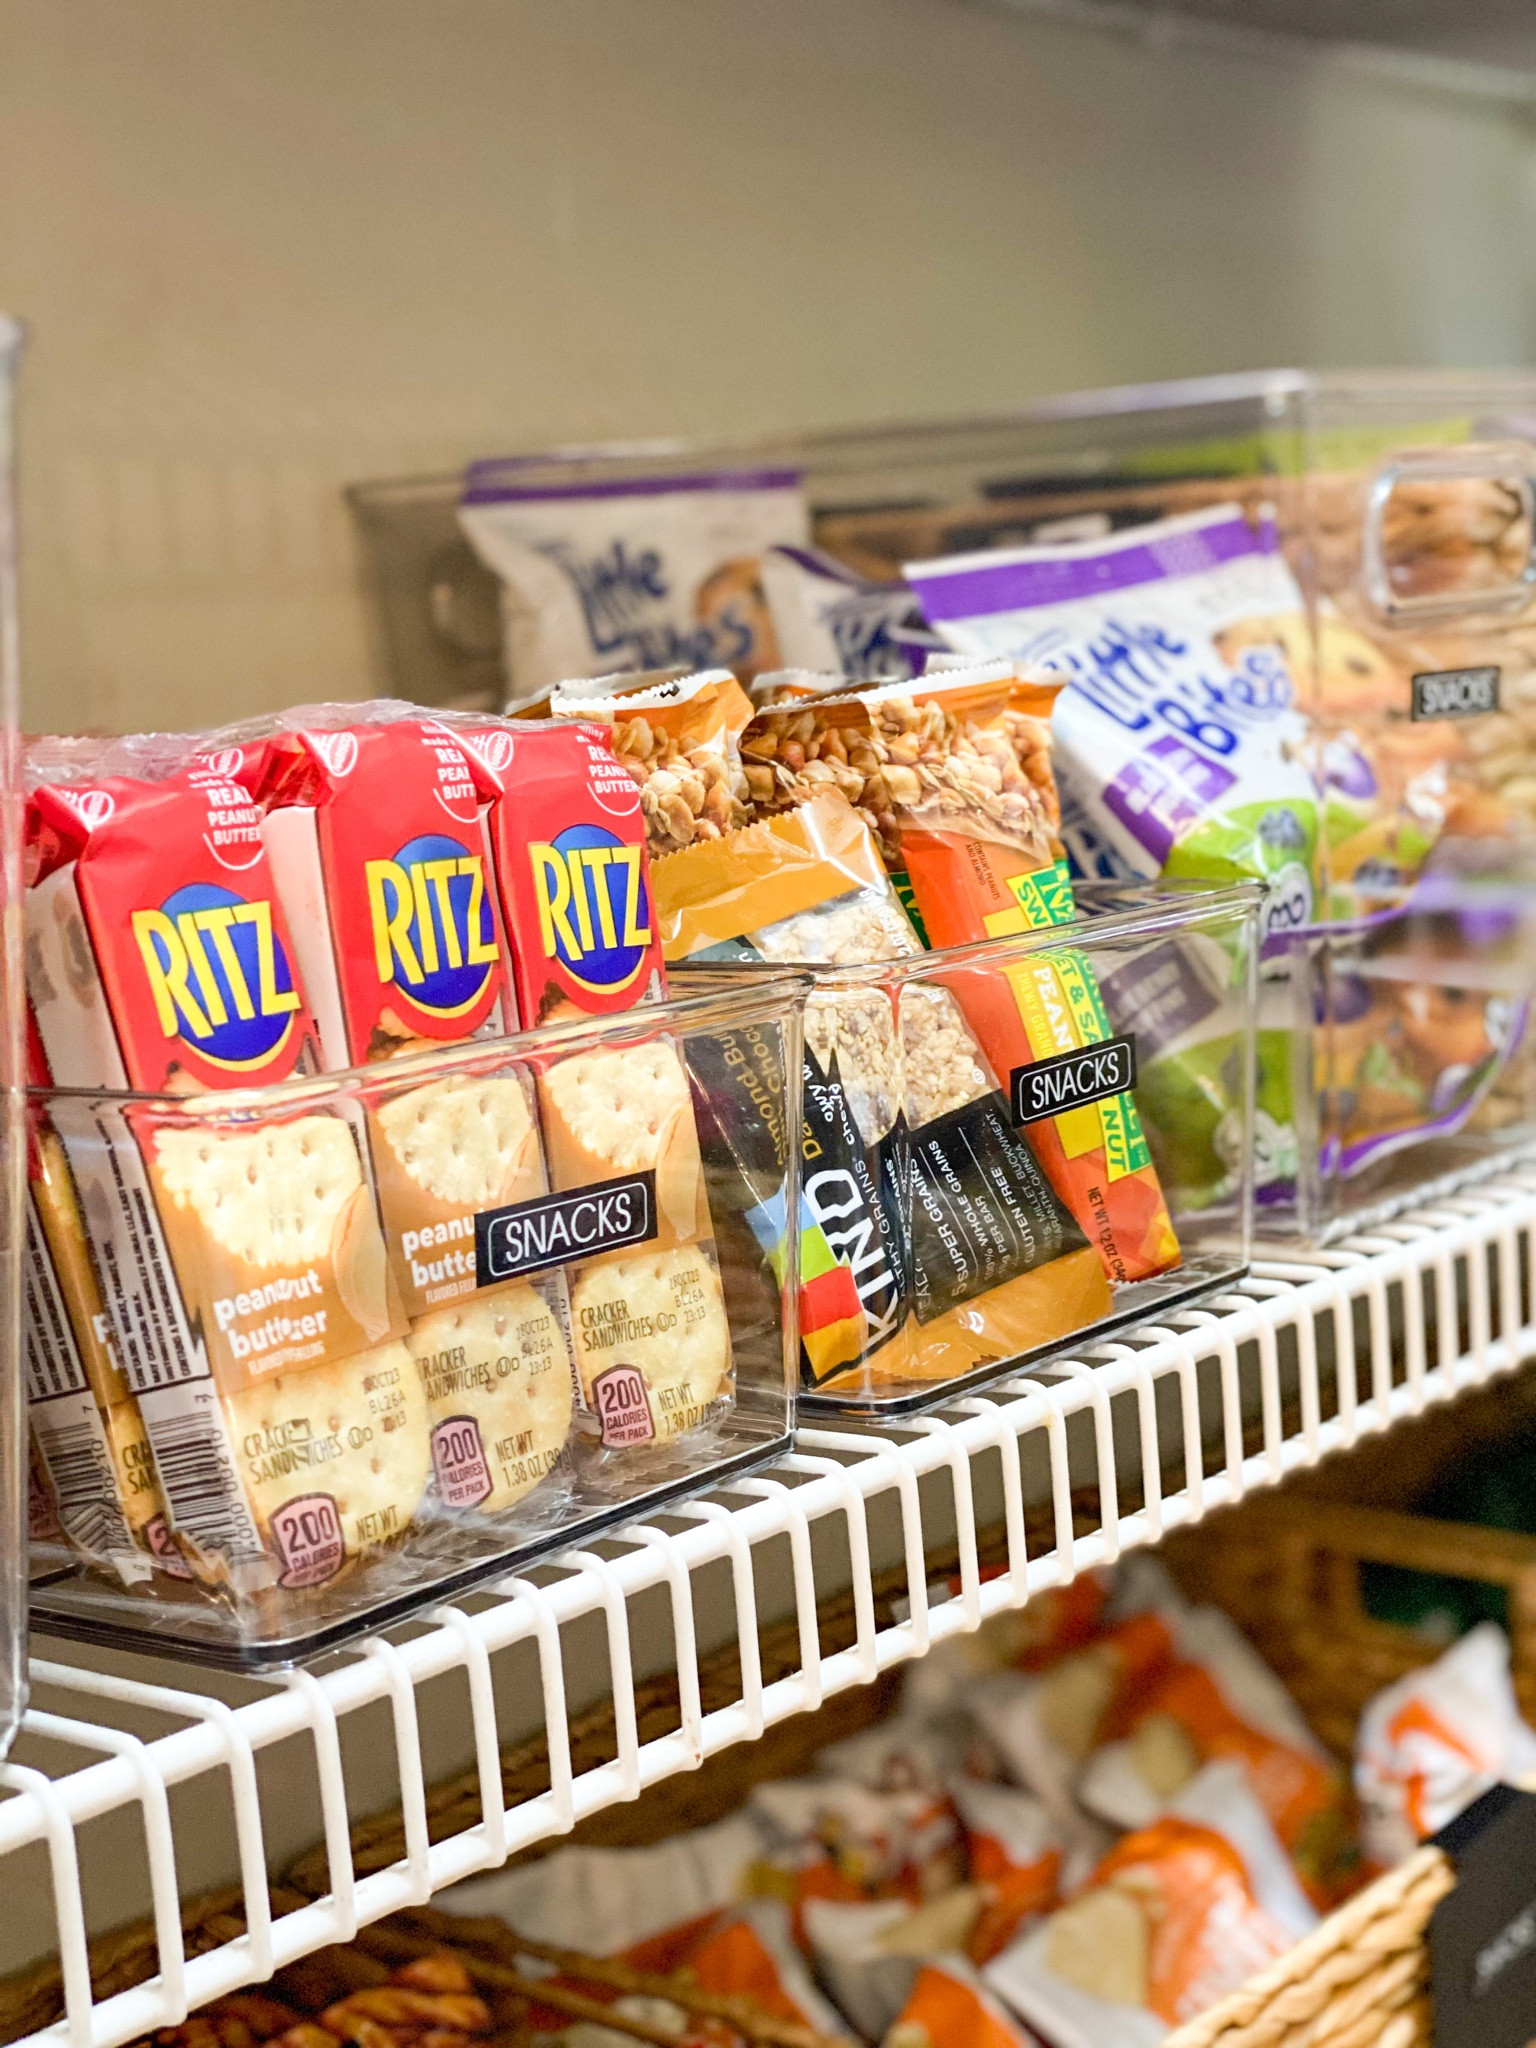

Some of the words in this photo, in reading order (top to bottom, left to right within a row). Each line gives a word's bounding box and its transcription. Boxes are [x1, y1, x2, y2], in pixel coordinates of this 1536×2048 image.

[435, 748, 467, 764] REA
[589, 764, 630, 778] PEANU
[443, 784, 477, 800] BUTT
[208, 808, 258, 827] PEANU
[966, 843, 977, 858] AND
[970, 856, 987, 887] ALMOND
[973, 841, 991, 874] CONTAINS
[984, 872, 1001, 901] PEANUTS
[365, 856, 499, 986] RITZ
[528, 842, 652, 961] RITZ
[131, 900, 301, 1039] RITZ
[1032, 966, 1074, 1049] PEAN
[1069, 985, 1084, 1005] &
[1031, 1013, 1056, 1058] GRANO
[1031, 1051, 1120, 1110] SNACKS
[801, 1120, 824, 1161] Da
[1102, 1109, 1128, 1172] NUT
[928, 1139, 963, 1194] GRAINS
[1017, 1142, 1040, 1188] QUINOA
[854, 1159, 891, 1234] GRAINS
[910, 1157, 944, 1223] GRAINS
[974, 1195, 995, 1224] BAR
[1087, 1186, 1104, 1208] NET
[505, 1192, 631, 1263] SNACKS
[957, 1194, 991, 1247] WHOLE
[1011, 1208, 1036, 1264] GLUTEN
[1094, 1207, 1110, 1226] WT
[402, 1214, 475, 1260] peanu
[938, 1223, 970, 1283] SUPER
[988, 1225, 1008, 1254] PER
[1103, 1243, 1118, 1258] OZ
[411, 1251, 477, 1288] butte
[804, 1168, 900, 1349] KIND
[952, 1282, 968, 1297] 5
[580, 1299, 631, 1330] CRACKER
[582, 1315, 653, 1353] SANDWICHES
[427, 1362, 491, 1402] ANDWICHES
[602, 1375, 643, 1414] 200
[657, 1386, 679, 1412] NET
[678, 1382, 696, 1404] WT
[605, 1407, 648, 1431] CALORIES
[686, 1406, 700, 1429] OZ
[438, 1427, 478, 1469] 200
[495, 1437, 515, 1463] NET
[502, 1460, 527, 1489] 1.38
[527, 1454, 545, 1479] OZ
[282, 1505, 336, 1554] 200
[356, 1515, 378, 1542] NET
[379, 1504, 400, 1531] WT
